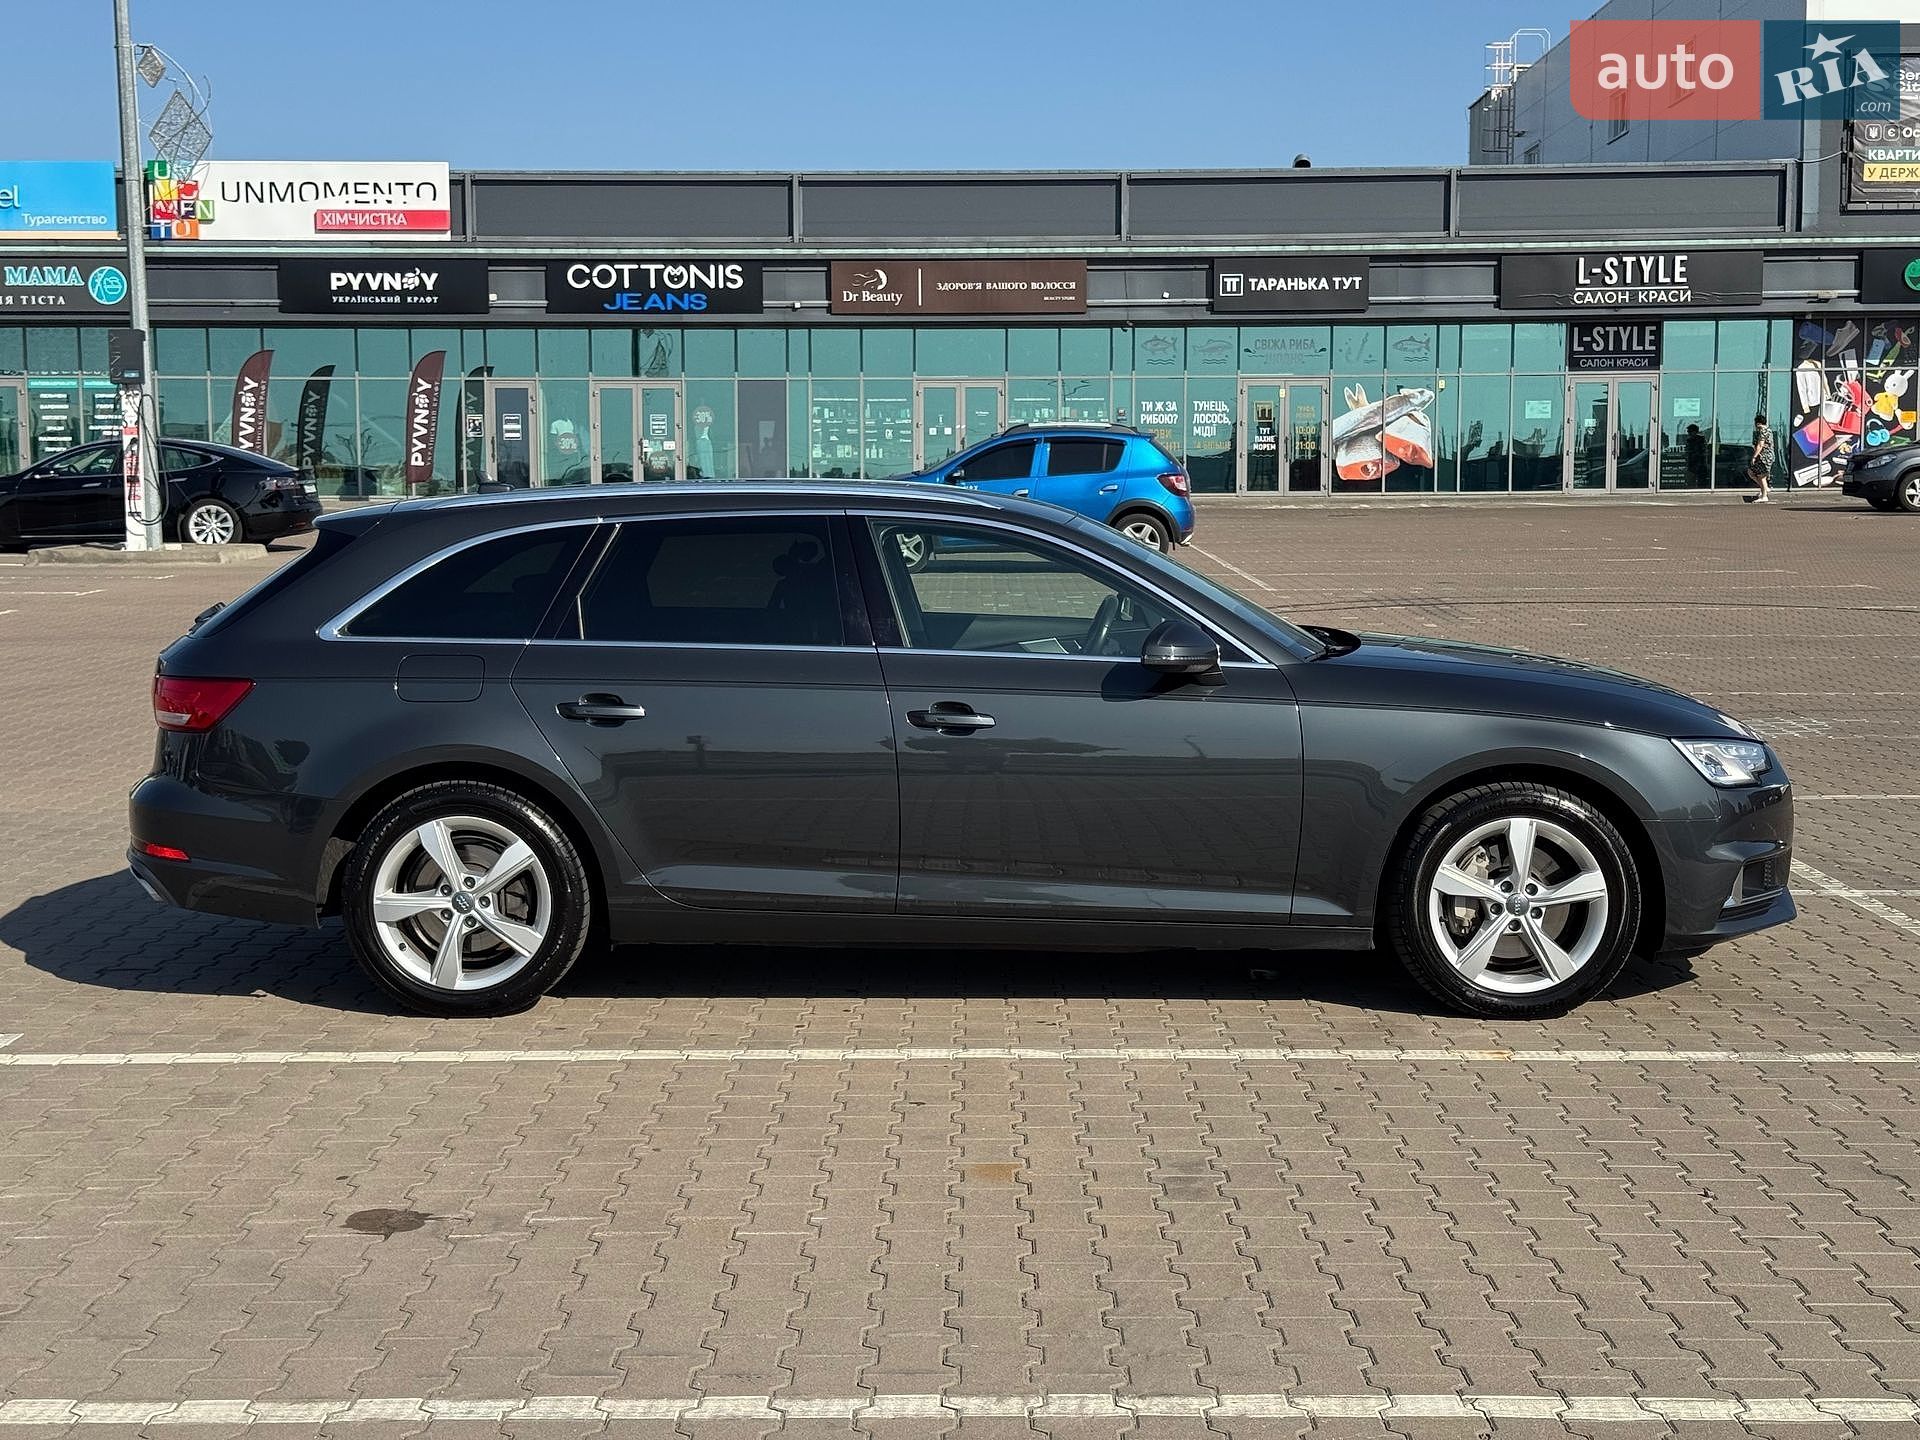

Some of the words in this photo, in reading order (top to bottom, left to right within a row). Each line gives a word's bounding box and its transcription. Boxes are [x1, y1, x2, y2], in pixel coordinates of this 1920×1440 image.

[1867, 167, 1876, 178] У
[1879, 168, 1919, 179] ДЕРЖ
[221, 181, 437, 204] UNMOMENTO
[21, 213, 107, 227] Турагентство
[323, 212, 407, 226] ХІМЧИСТКА
[4, 266, 85, 286] МАМА
[1578, 255, 1688, 285] L-STYLE
[566, 264, 744, 289] COTTONIS
[986, 282, 1028, 290] ВАШОГО
[1031, 281, 1076, 290] ВОЛОССЯ
[1249, 277, 1329, 291] ТАРАНЬКА
[1332, 276, 1362, 290] ТУТ
[20, 295, 66, 305] ТІСТА
[332, 295, 401, 304] УКРАЇНСЬКИЙ
[407, 296, 439, 304] КРАФТ
[602, 292, 708, 311] JEANS
[843, 290, 859, 302] Dr
[862, 290, 903, 305] Beauty
[1573, 291, 1630, 304] САЛОН
[1638, 290, 1692, 303] КРАСИ
[1254, 338, 1286, 350] СВІЖА
[1289, 338, 1316, 350] РИБА
[1573, 326, 1657, 352] L-STYLE
[1580, 359, 1614, 368] САЛОН
[1617, 358, 1649, 367] КРАСИ
[1141, 401, 1153, 412] ТИ
[1155, 401, 1164, 411] Ж
[1166, 401, 1177, 411] ЗА
[1193, 401, 1230, 413] ТУНЕЦЬ,
[1140, 413, 1178, 424] РИБОЮ?
[1193, 413, 1231, 425] ЛОСОСЬ,
[1193, 424, 1216, 437] МІДІЇ
[1295, 426, 1316, 434] 10:00
[1295, 441, 1316, 450] 21:00
